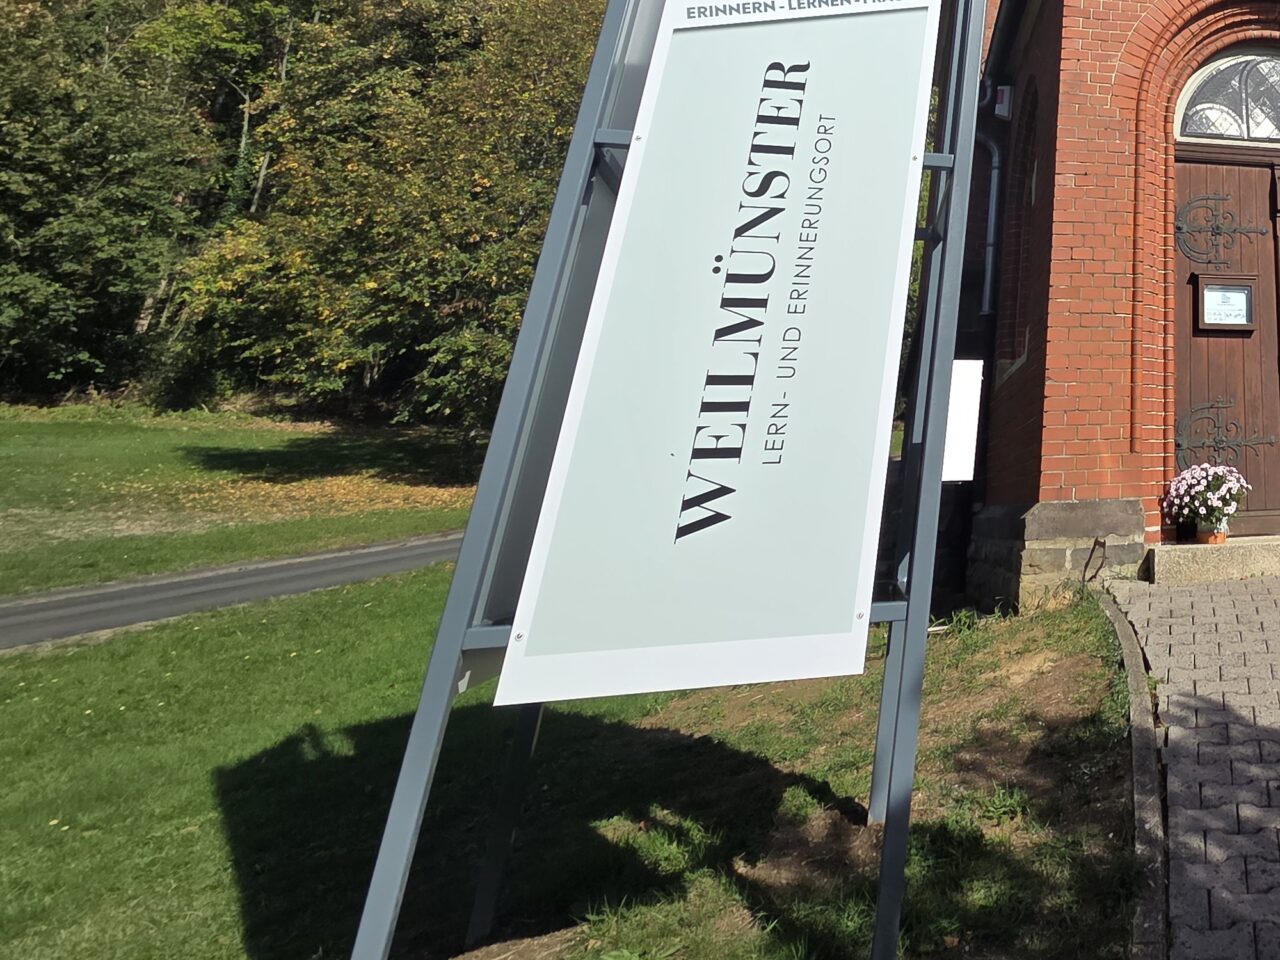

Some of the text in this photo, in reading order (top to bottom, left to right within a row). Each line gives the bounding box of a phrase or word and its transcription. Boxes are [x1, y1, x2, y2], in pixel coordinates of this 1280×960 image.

[686, 1, 776, 20] ERINNERN
[674, 60, 811, 544] WEILMÜNSTER
[762, 114, 836, 465] LERN- UND ERINNERUNGSORT
